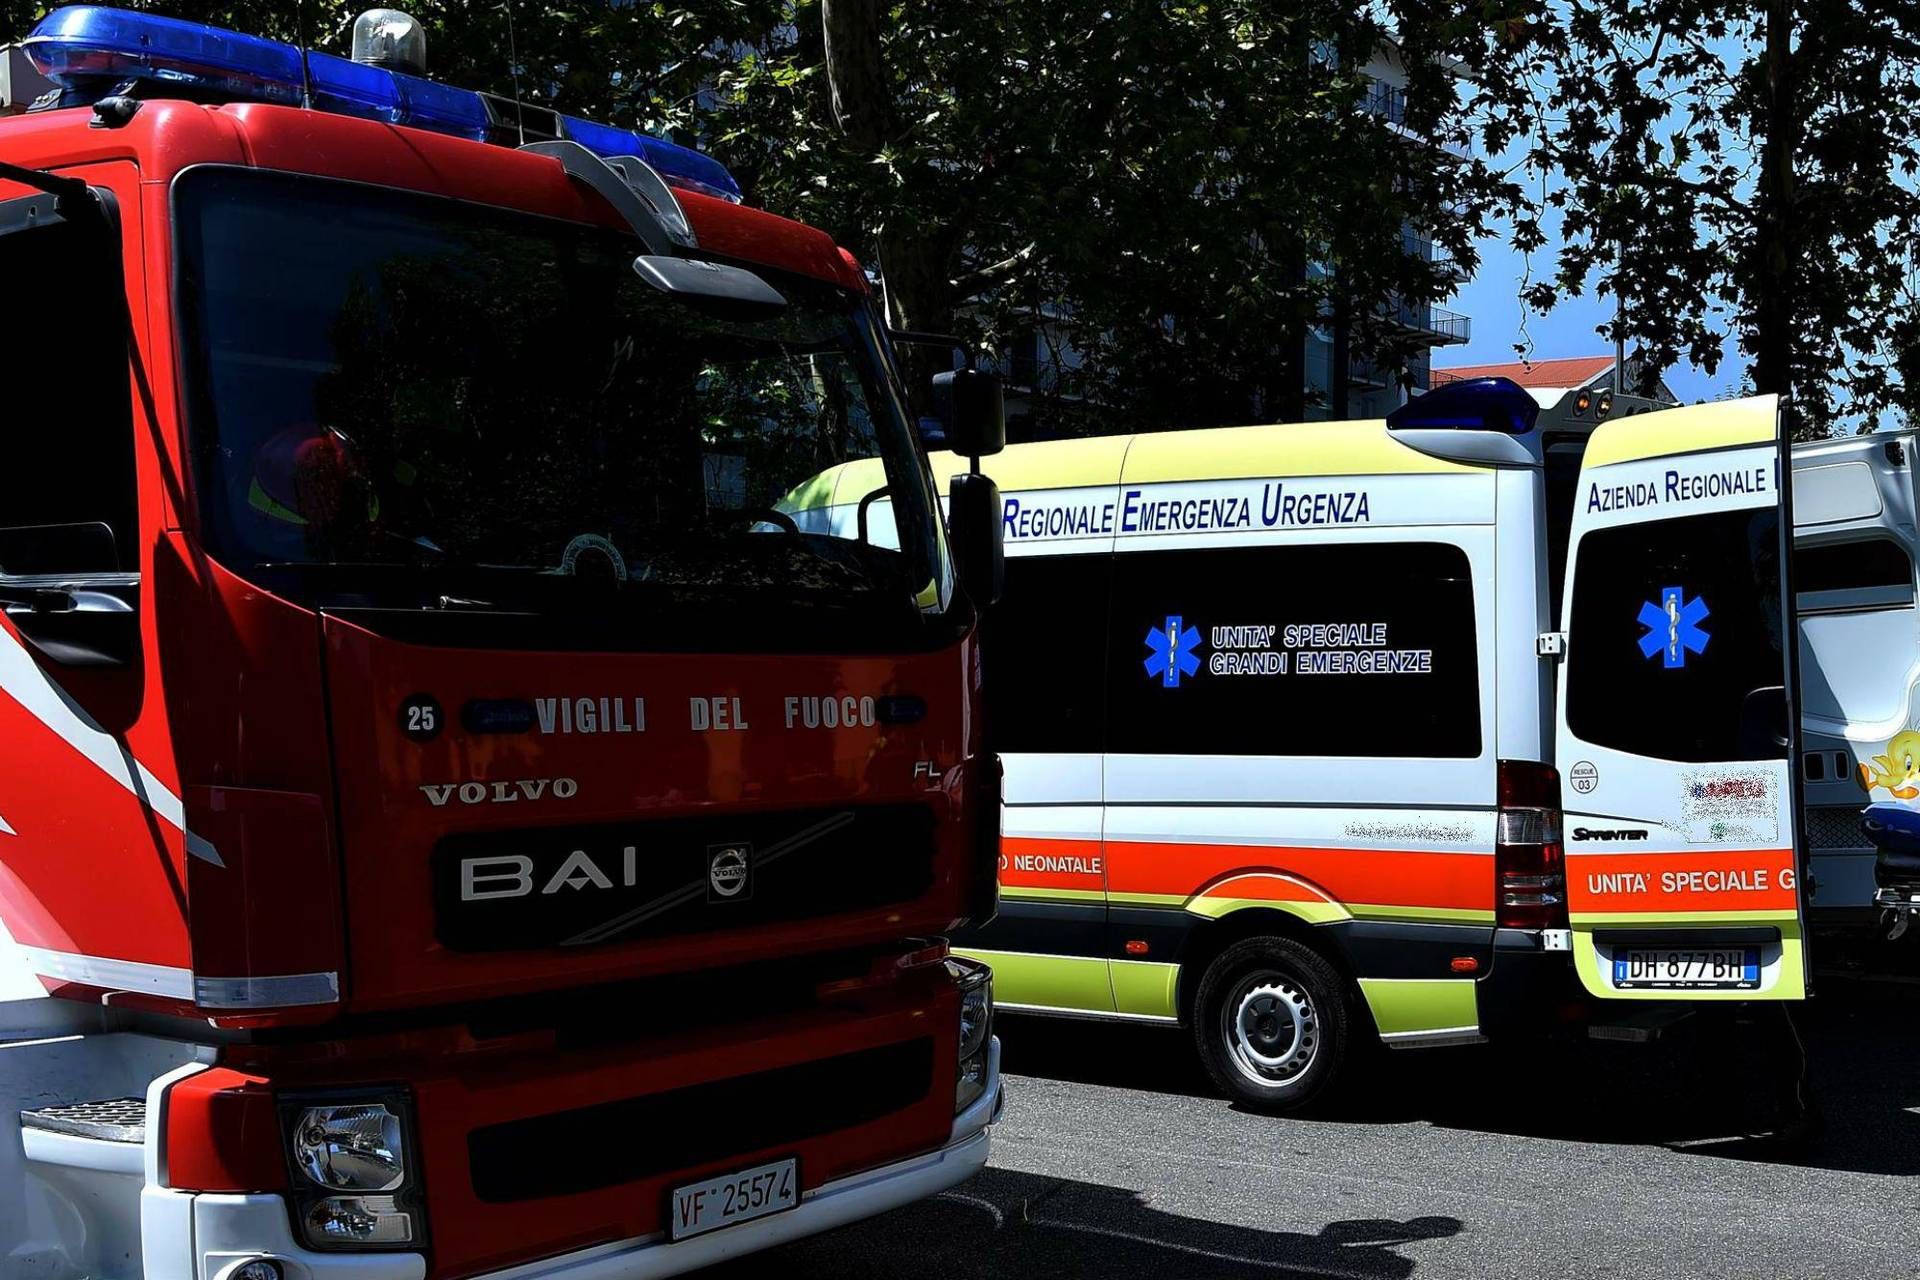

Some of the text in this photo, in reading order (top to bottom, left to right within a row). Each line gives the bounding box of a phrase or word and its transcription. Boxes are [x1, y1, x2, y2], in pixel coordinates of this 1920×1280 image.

[1587, 482, 1658, 514] AZIENDA
[1665, 470, 1766, 502] REGIONALE
[1003, 483, 1370, 538] REGIONALE EMERGENZA URGENZA
[1212, 624, 1386, 648] UNITA' SPECIALE
[1210, 650, 1432, 675] GRANDI EMERGENZE
[408, 706, 434, 731] 25
[536, 698, 646, 733] VIGILI
[690, 697, 748, 730] DEL
[784, 696, 876, 729] FUOCO
[914, 761, 941, 778] FL
[419, 777, 578, 806] VOLVO
[1578, 780, 1590, 791] 03
[461, 846, 636, 901] BAI
[1014, 855, 1102, 873] NEONATALE
[1588, 872, 1650, 894] UNITA'
[1661, 869, 1768, 893] SPECIALE
[722, 1168, 792, 1217] 25574
